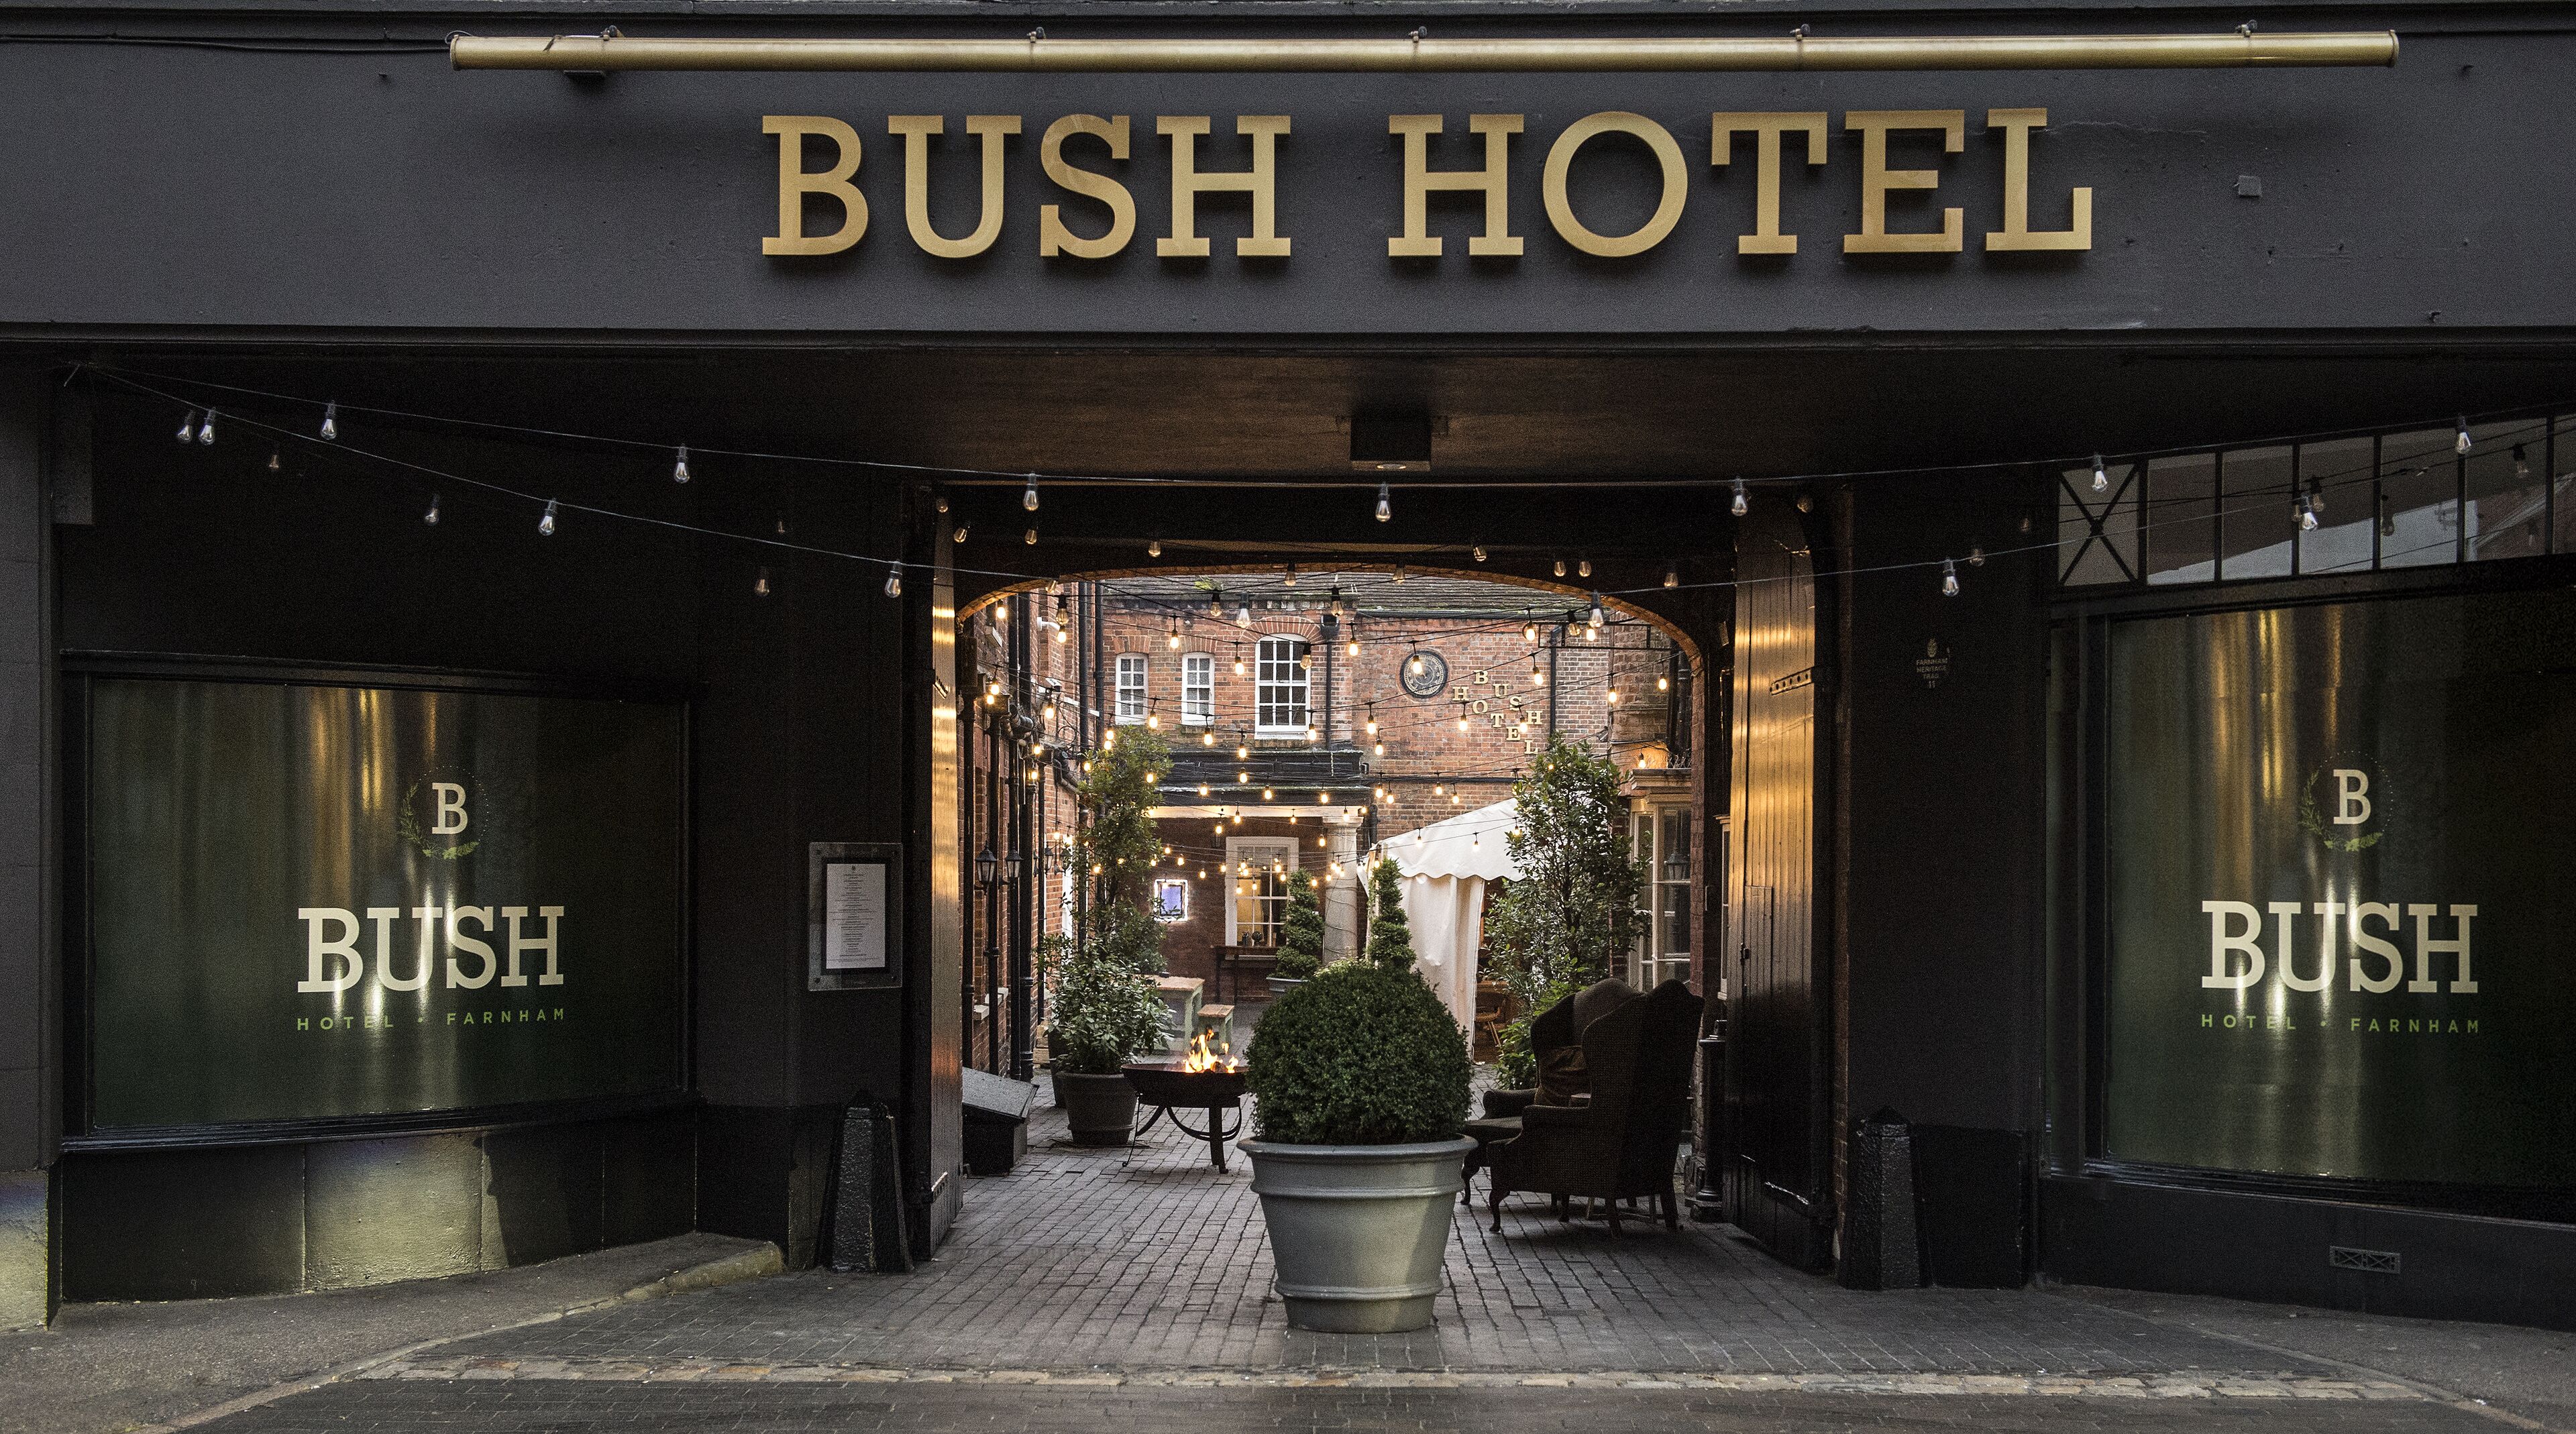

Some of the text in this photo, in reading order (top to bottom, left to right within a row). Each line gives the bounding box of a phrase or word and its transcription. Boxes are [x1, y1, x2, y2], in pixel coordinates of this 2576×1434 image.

[762, 107, 2092, 258] BUSH HOTEL
[1452, 686, 1538, 755] HOTEL
[1473, 669, 1543, 725] BUSH
[431, 782, 468, 834] B
[2333, 769, 2371, 825] B
[297, 905, 564, 993] BUSH
[2202, 900, 2478, 993] BUSH
[297, 1007, 564, 1030] HOTEL FARNHAM
[2202, 1014, 2479, 1033] HOTEL FARNHAM
